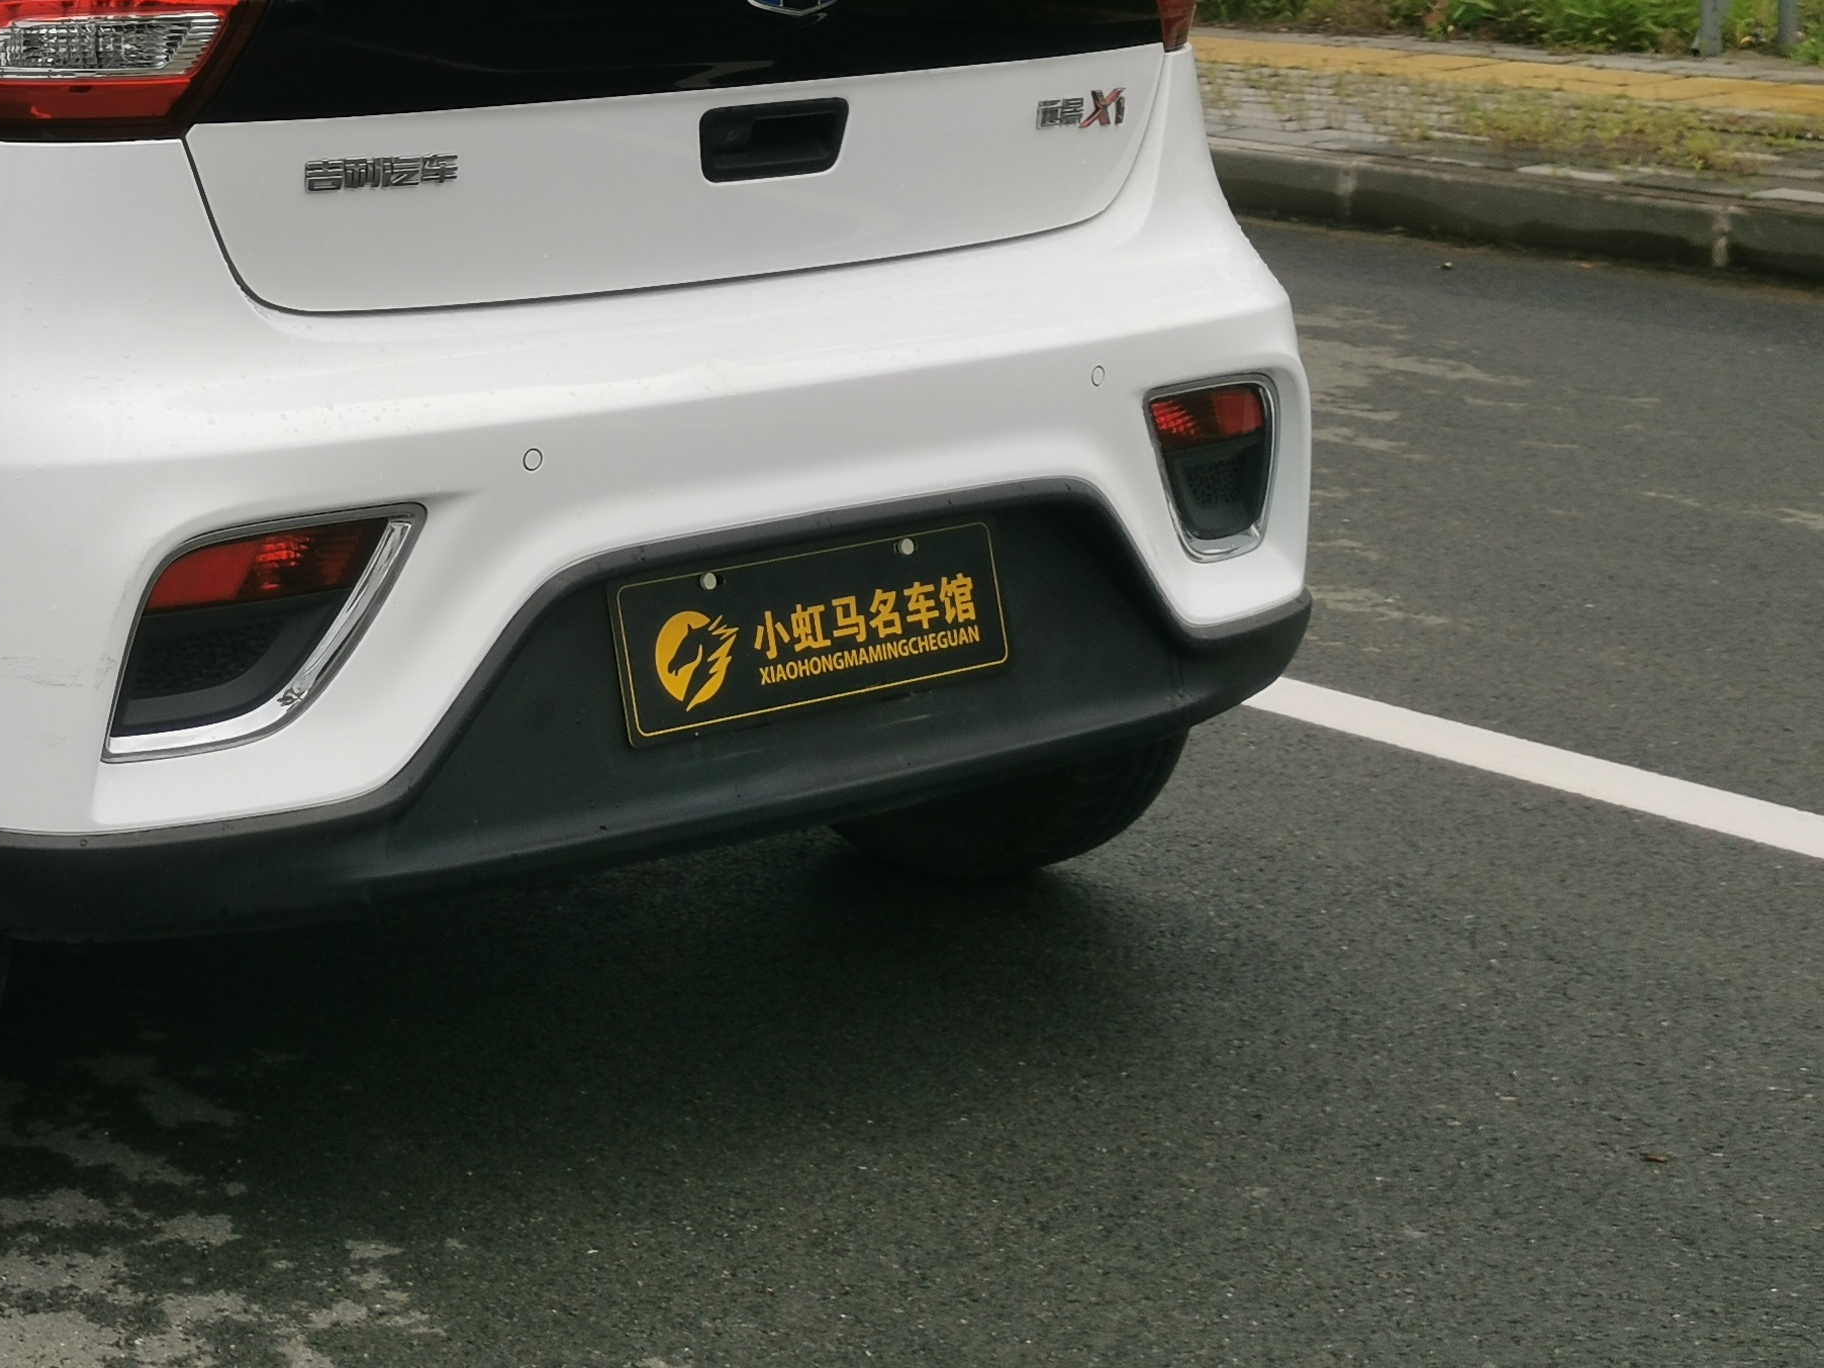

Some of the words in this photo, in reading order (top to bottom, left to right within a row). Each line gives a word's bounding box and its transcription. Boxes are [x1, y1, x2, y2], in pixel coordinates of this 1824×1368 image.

[305, 153, 459, 193] 吉利汽车
[754, 573, 976, 660] 小虹马名车馆
[759, 625, 980, 685] XIAOHONGMAMINGCHEGUAN
